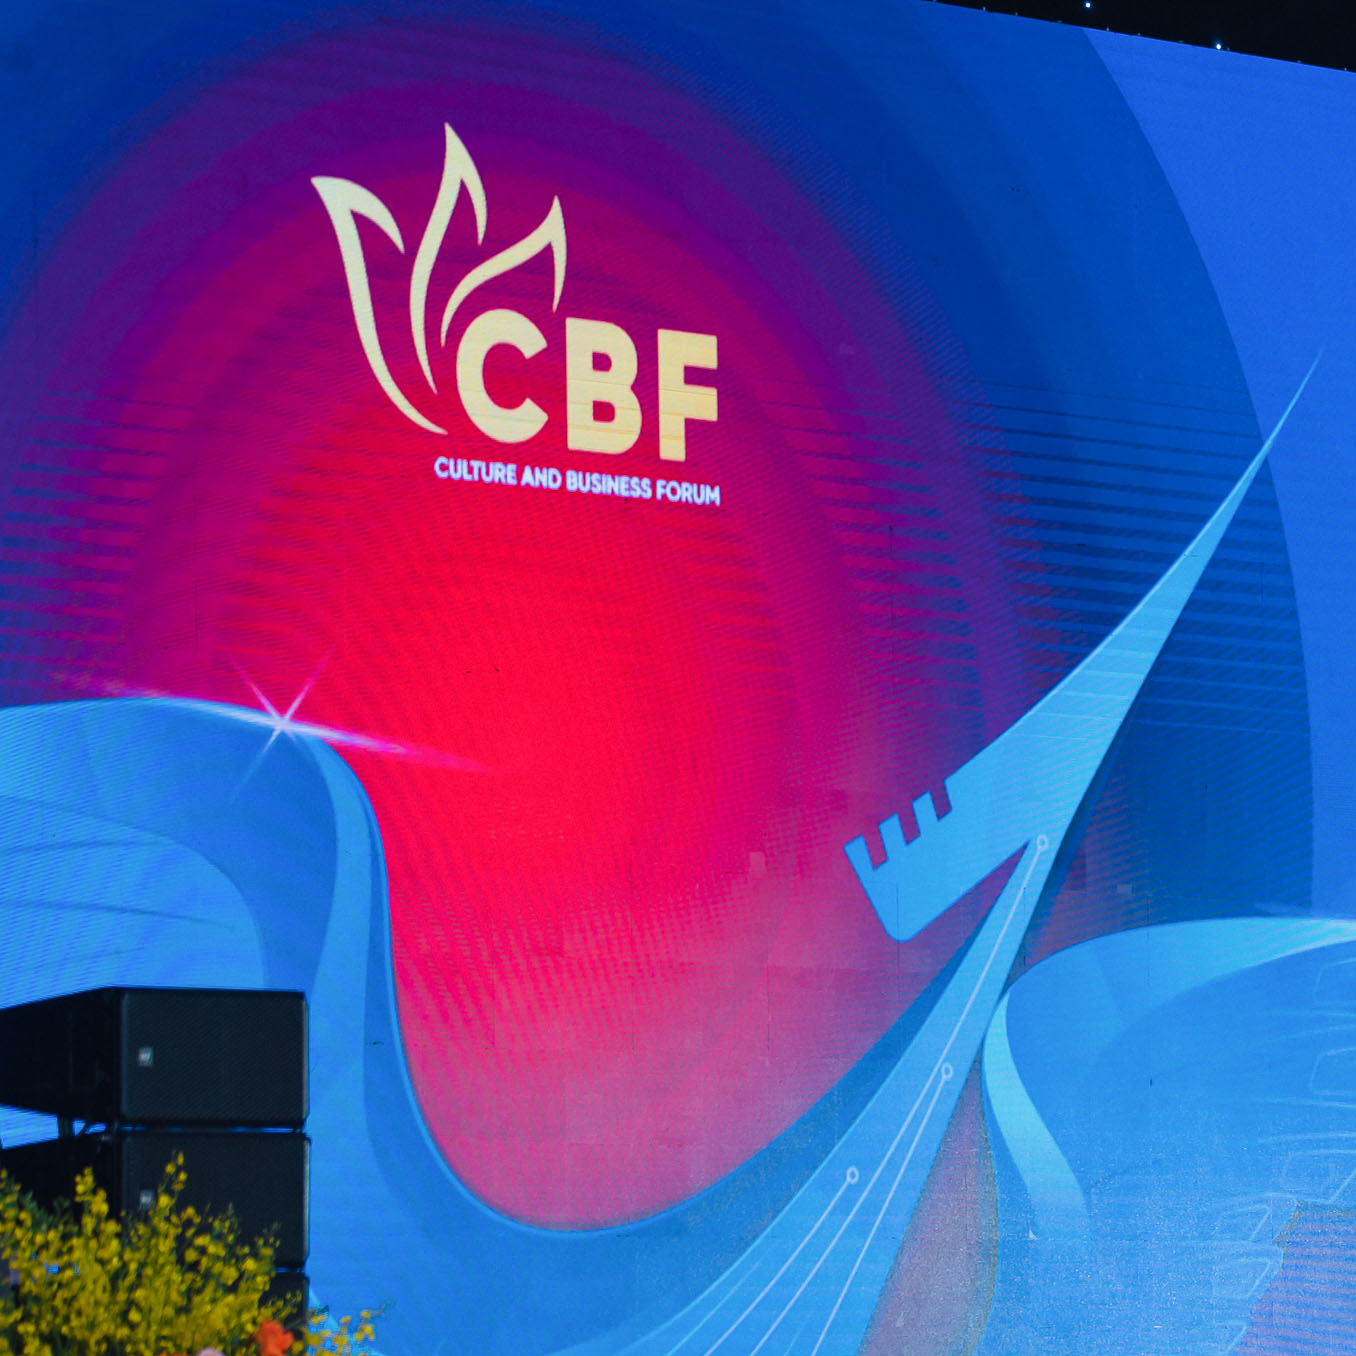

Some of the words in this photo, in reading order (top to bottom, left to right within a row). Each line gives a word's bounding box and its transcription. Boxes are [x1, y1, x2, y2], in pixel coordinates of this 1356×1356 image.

[457, 309, 718, 462] CBF
[434, 456, 517, 485] CULTURE
[521, 465, 562, 491] AND
[566, 471, 652, 500] BUSINESS
[656, 478, 720, 507] FORUM
